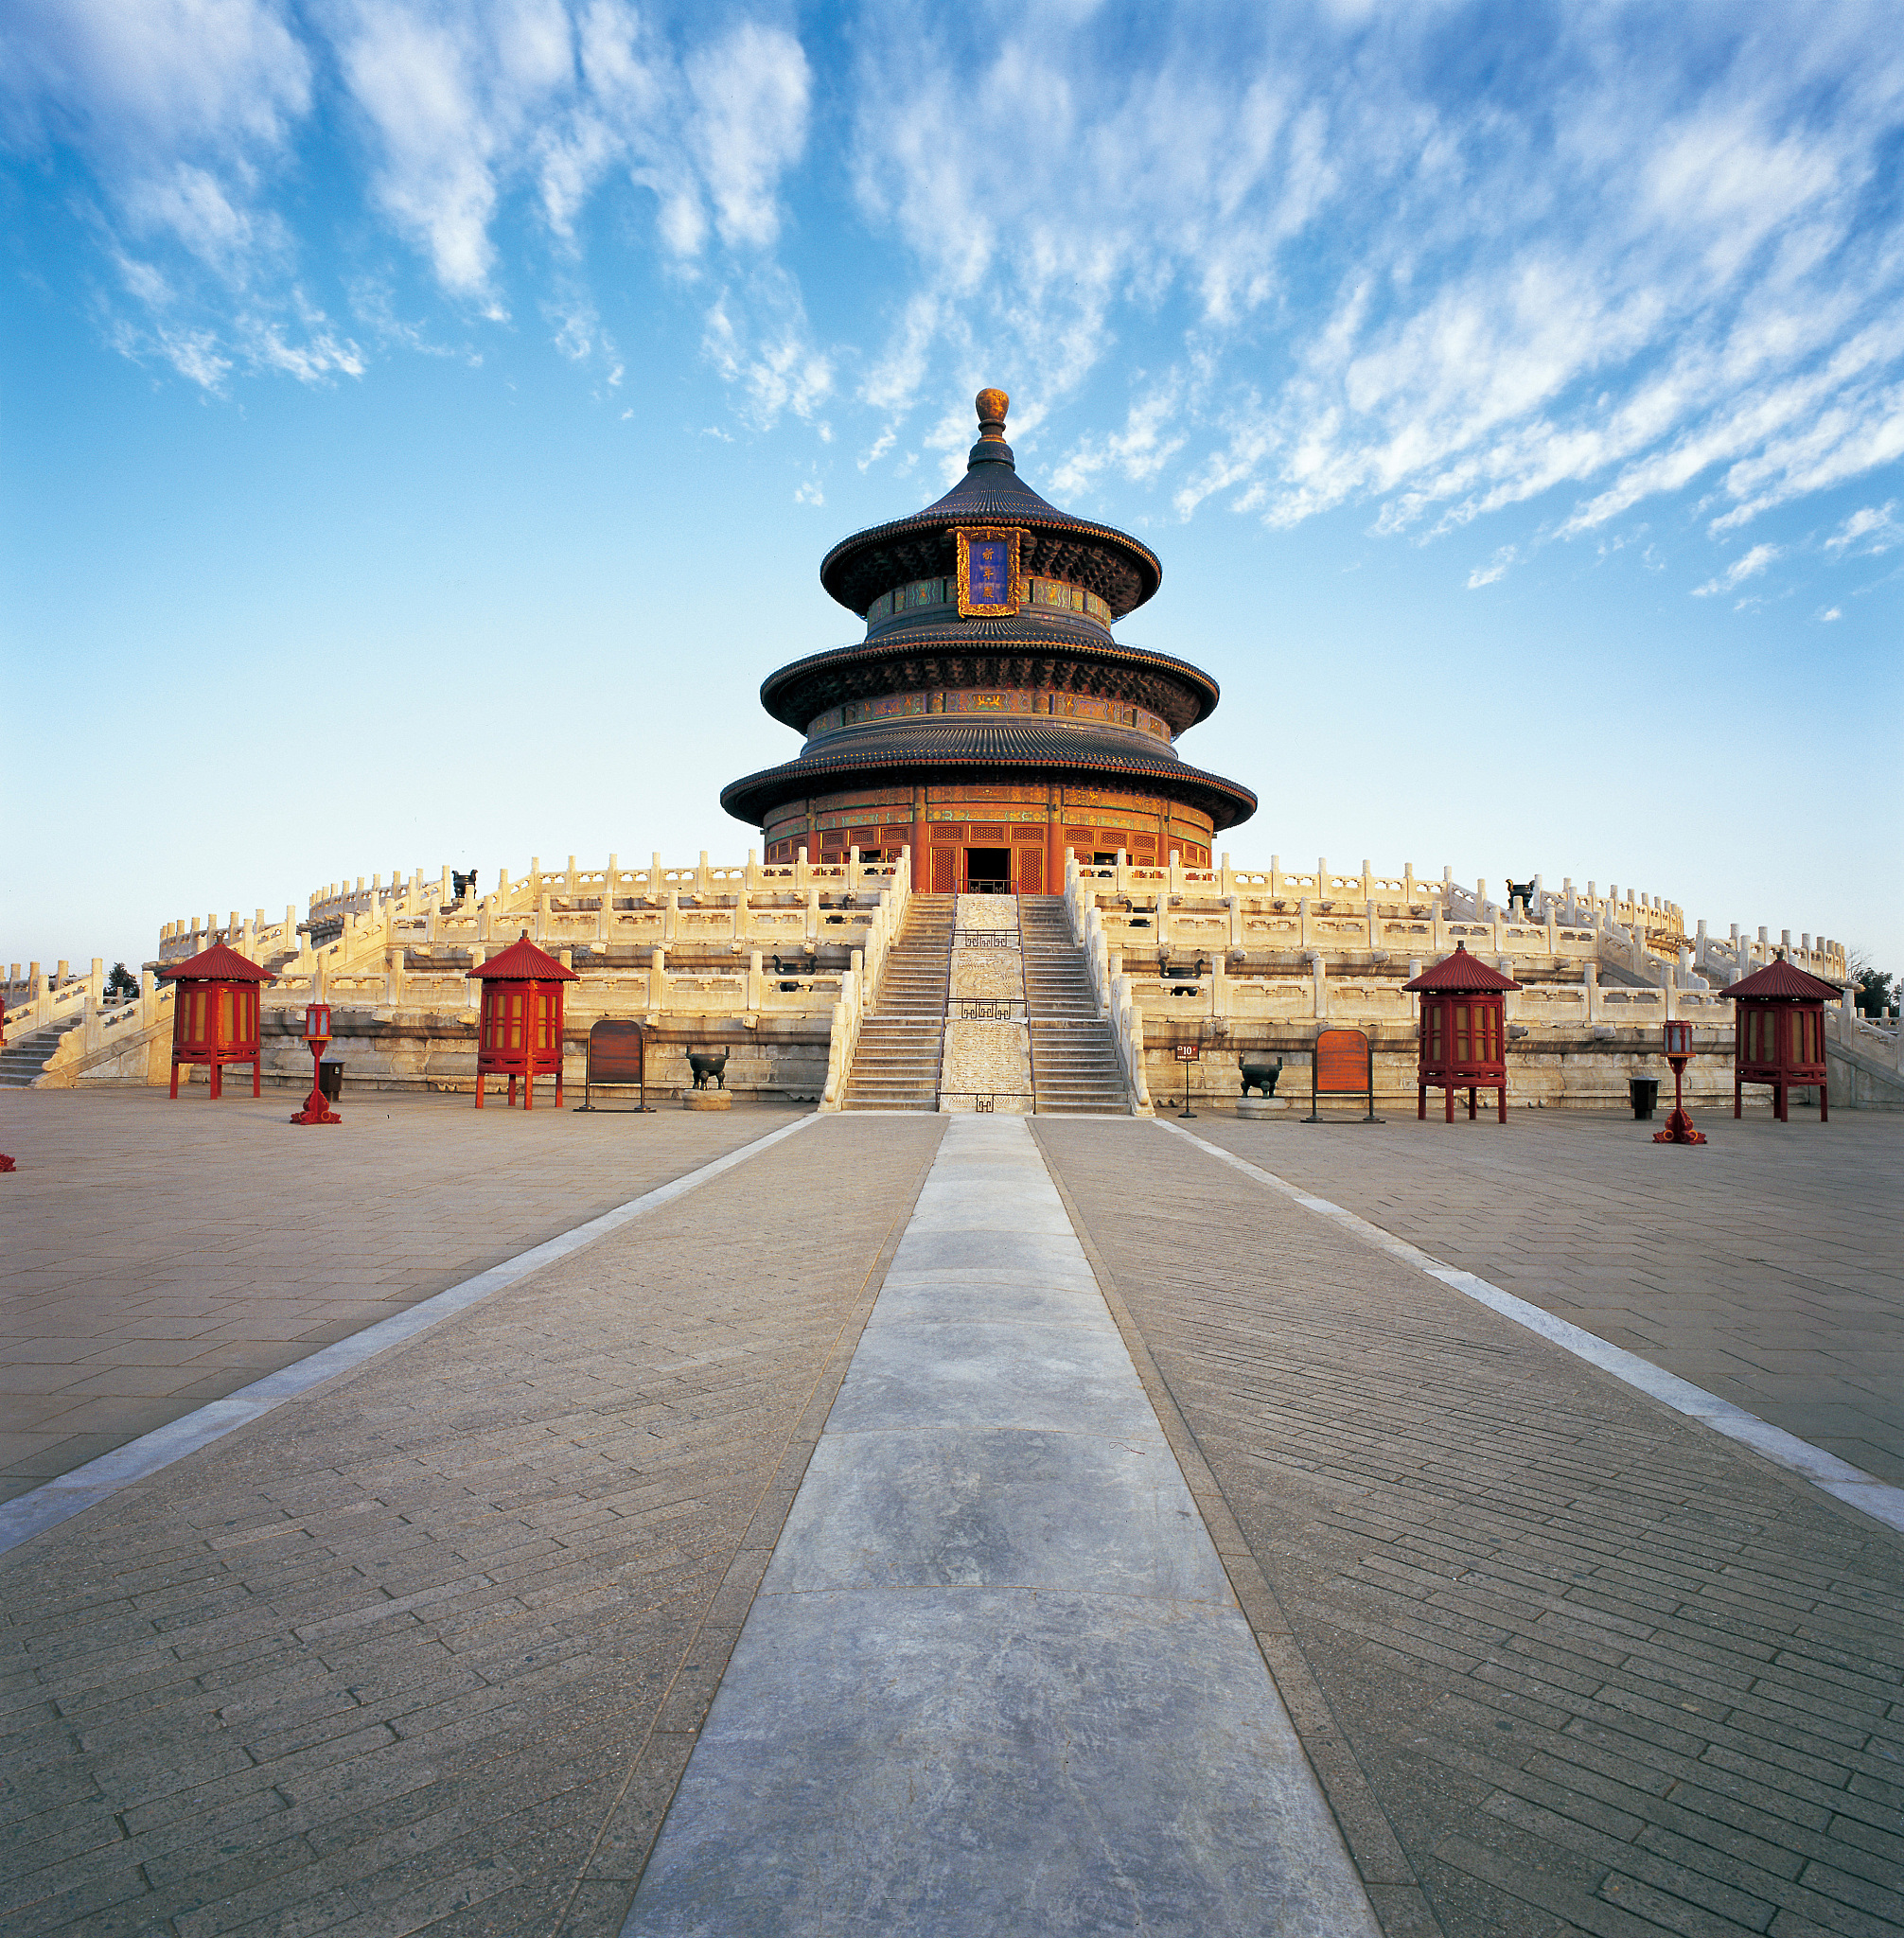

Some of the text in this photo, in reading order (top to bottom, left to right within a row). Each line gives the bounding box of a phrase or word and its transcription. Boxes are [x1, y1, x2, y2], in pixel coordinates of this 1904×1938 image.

[982, 548, 994, 598] 祈年殿
[1183, 1046, 1192, 1055] 10
